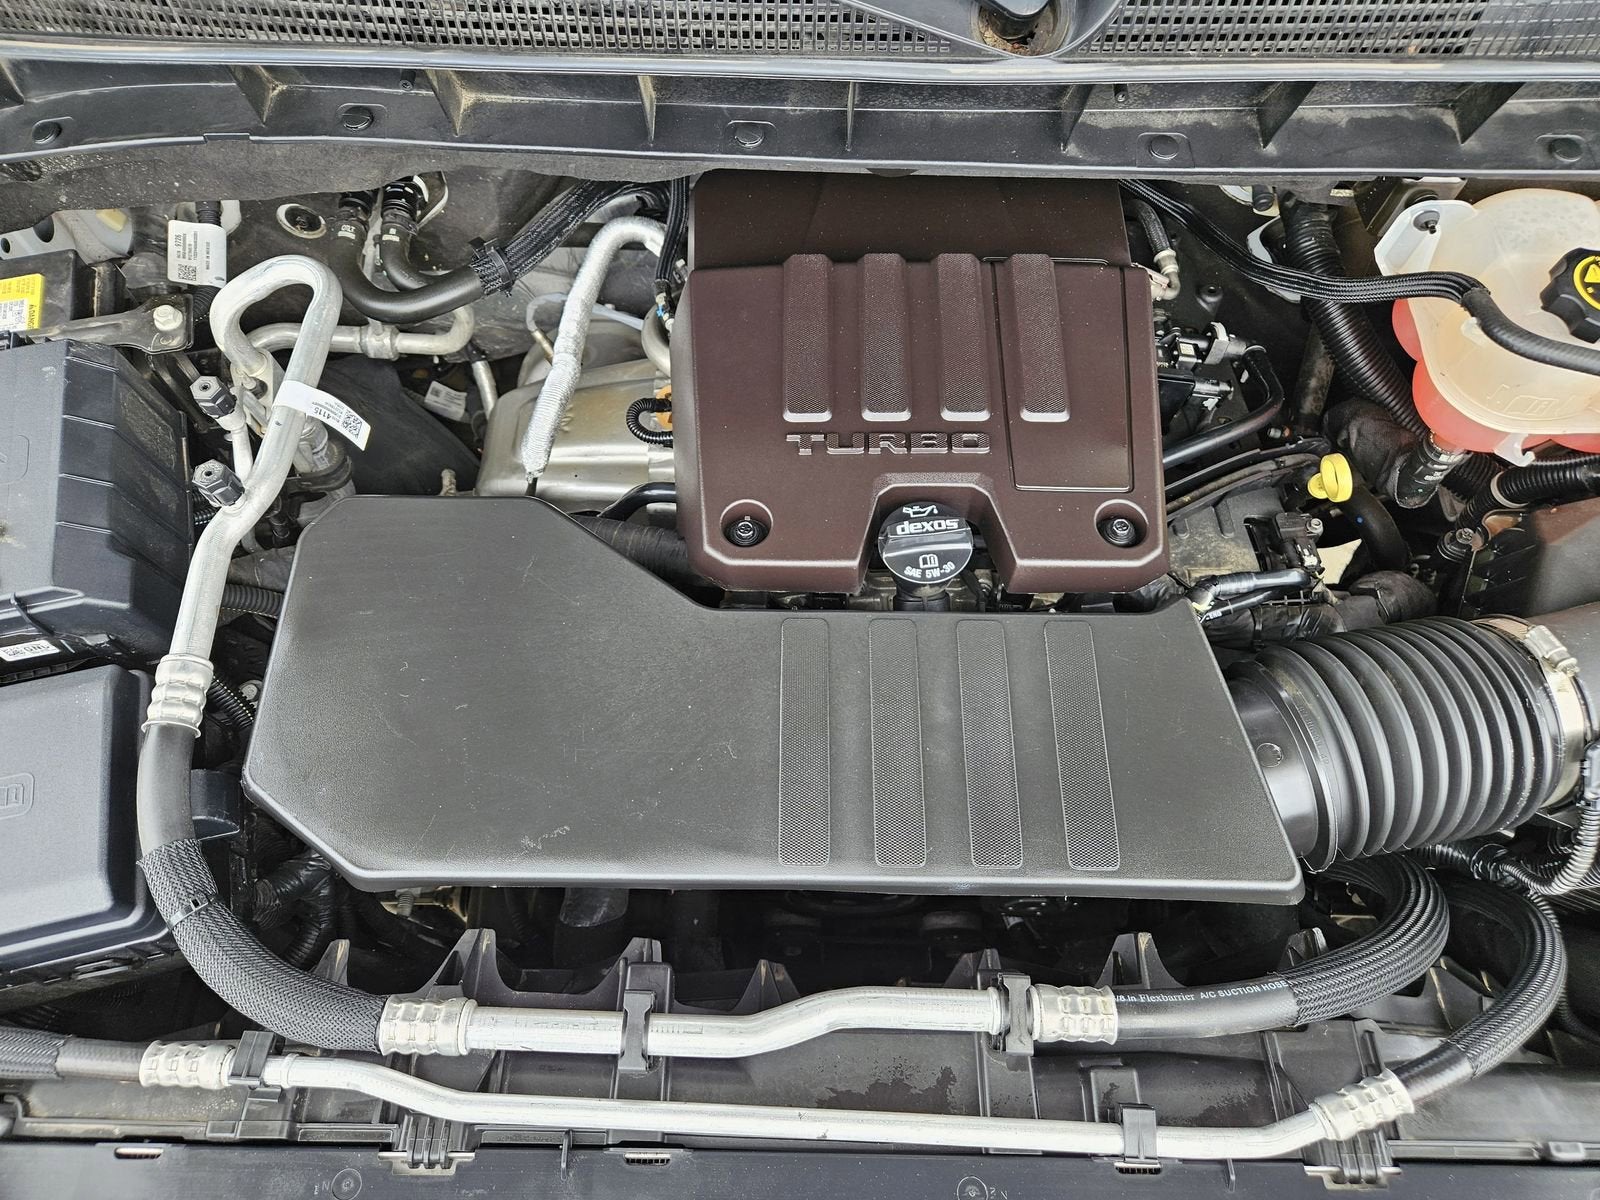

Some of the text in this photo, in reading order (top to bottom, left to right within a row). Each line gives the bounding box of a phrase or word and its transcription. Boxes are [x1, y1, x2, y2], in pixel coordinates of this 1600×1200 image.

[786, 432, 991, 455] TURBO
[896, 518, 960, 535] dexos
[904, 561, 956, 578] SAE 5W-30
[1115, 994, 1126, 1002] /8
[1139, 993, 1196, 1002] Flexbarrier
[1200, 990, 1217, 1000] A/C
[1220, 985, 1261, 997] SUCTION
[1263, 980, 1288, 991] HOSE
